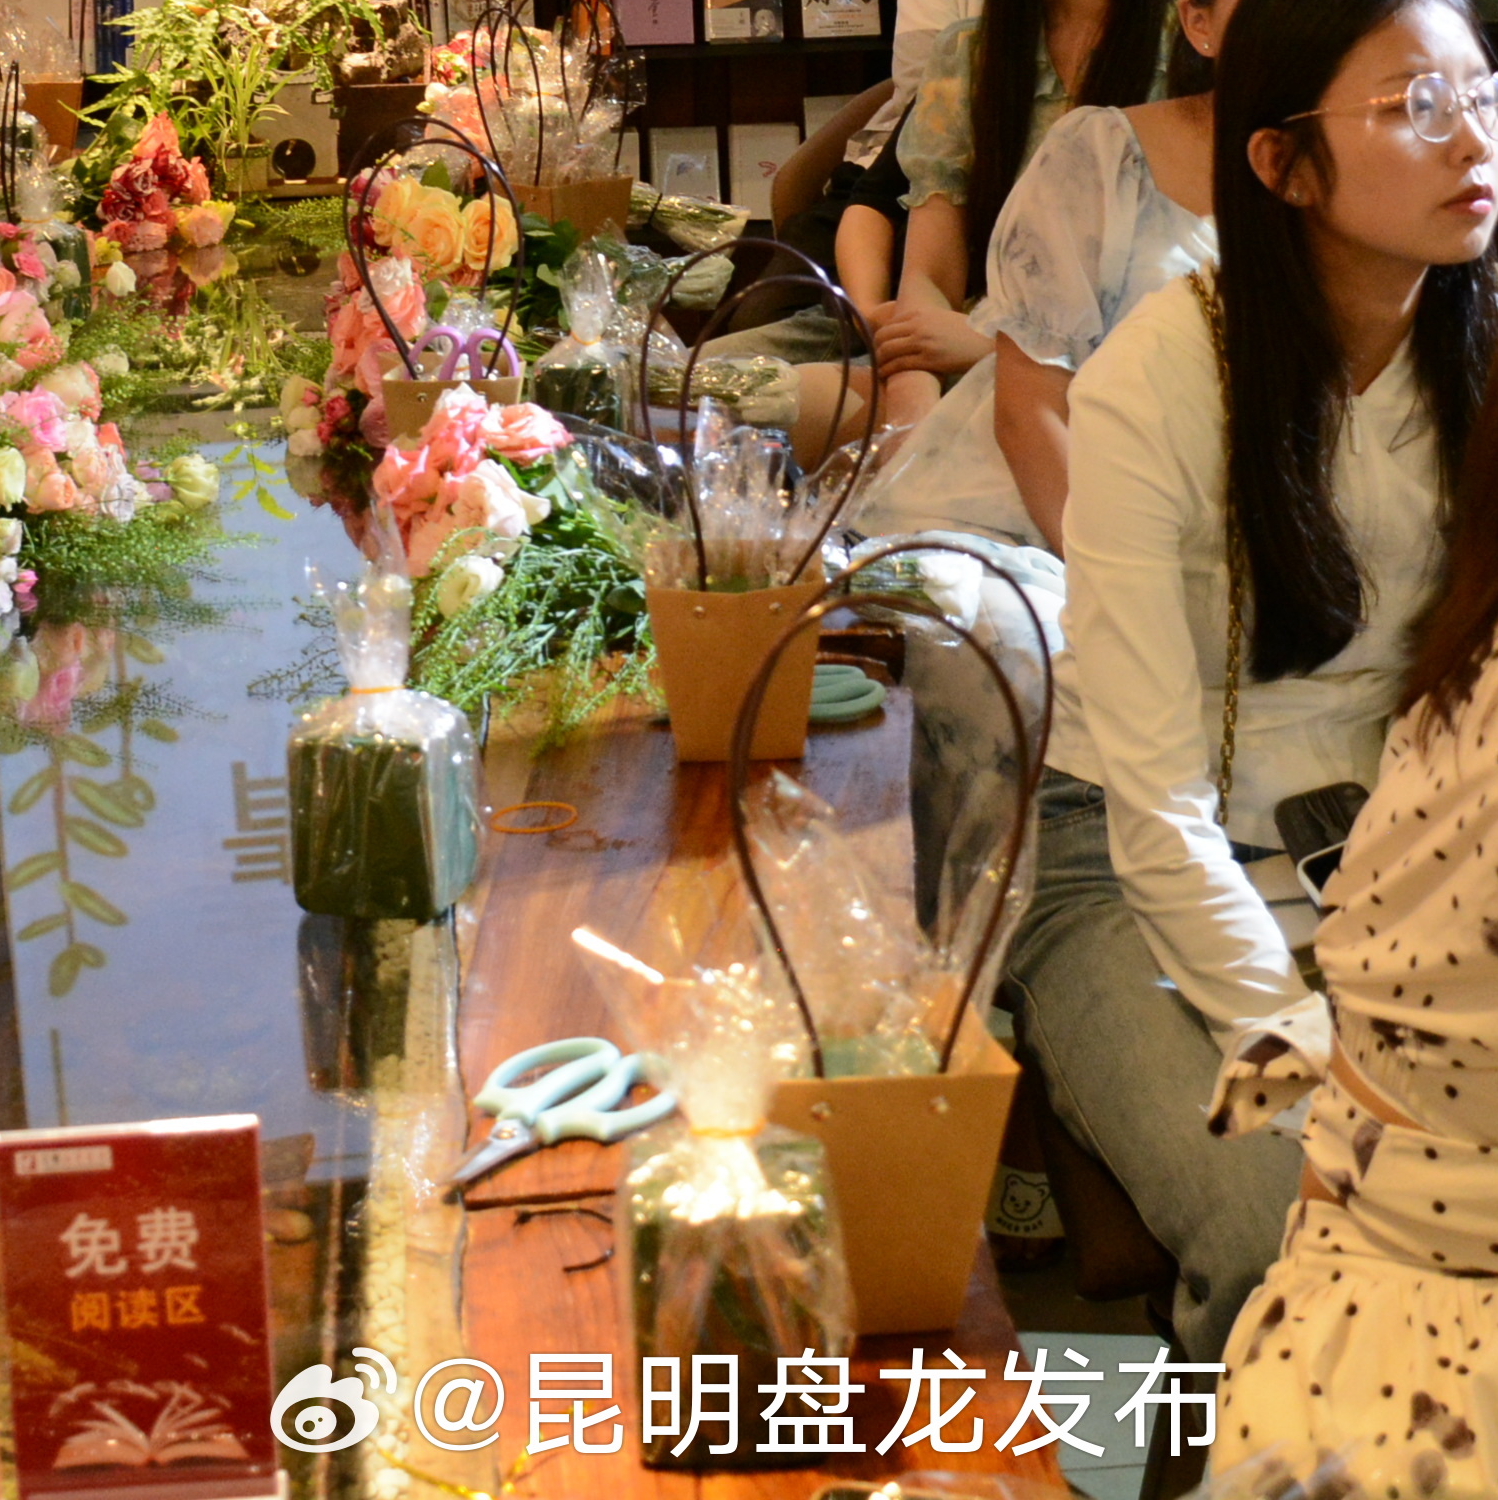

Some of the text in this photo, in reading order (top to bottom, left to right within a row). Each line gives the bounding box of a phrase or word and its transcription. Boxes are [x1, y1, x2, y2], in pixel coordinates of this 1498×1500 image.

[58, 1204, 200, 1280] 免费
[70, 1284, 206, 1332] 阅读区
